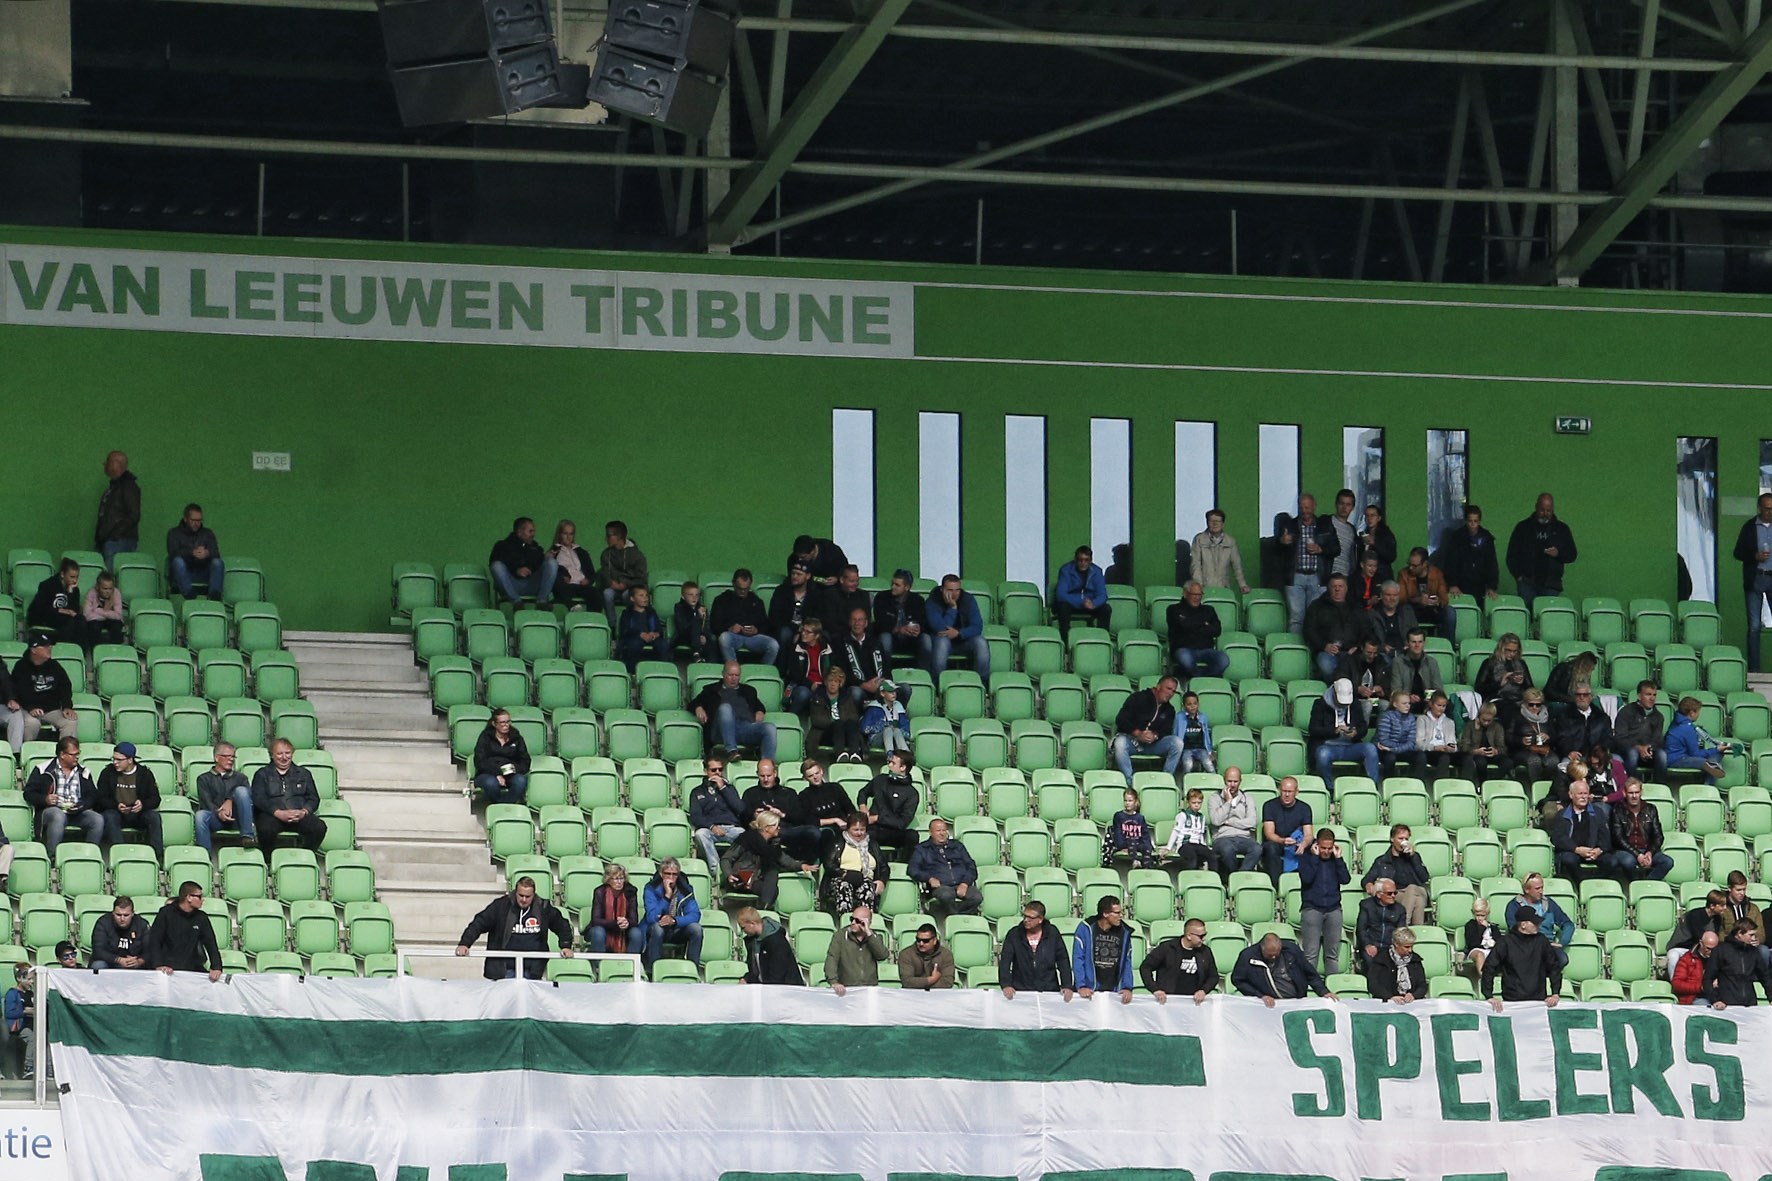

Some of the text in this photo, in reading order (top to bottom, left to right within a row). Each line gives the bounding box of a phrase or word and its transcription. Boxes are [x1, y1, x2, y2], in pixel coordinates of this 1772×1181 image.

[8, 260, 891, 345] VAN LEEUWEN TRIBUNE
[1282, 1008, 1745, 1123] SPELERS
[0, 1126, 52, 1158] tie
